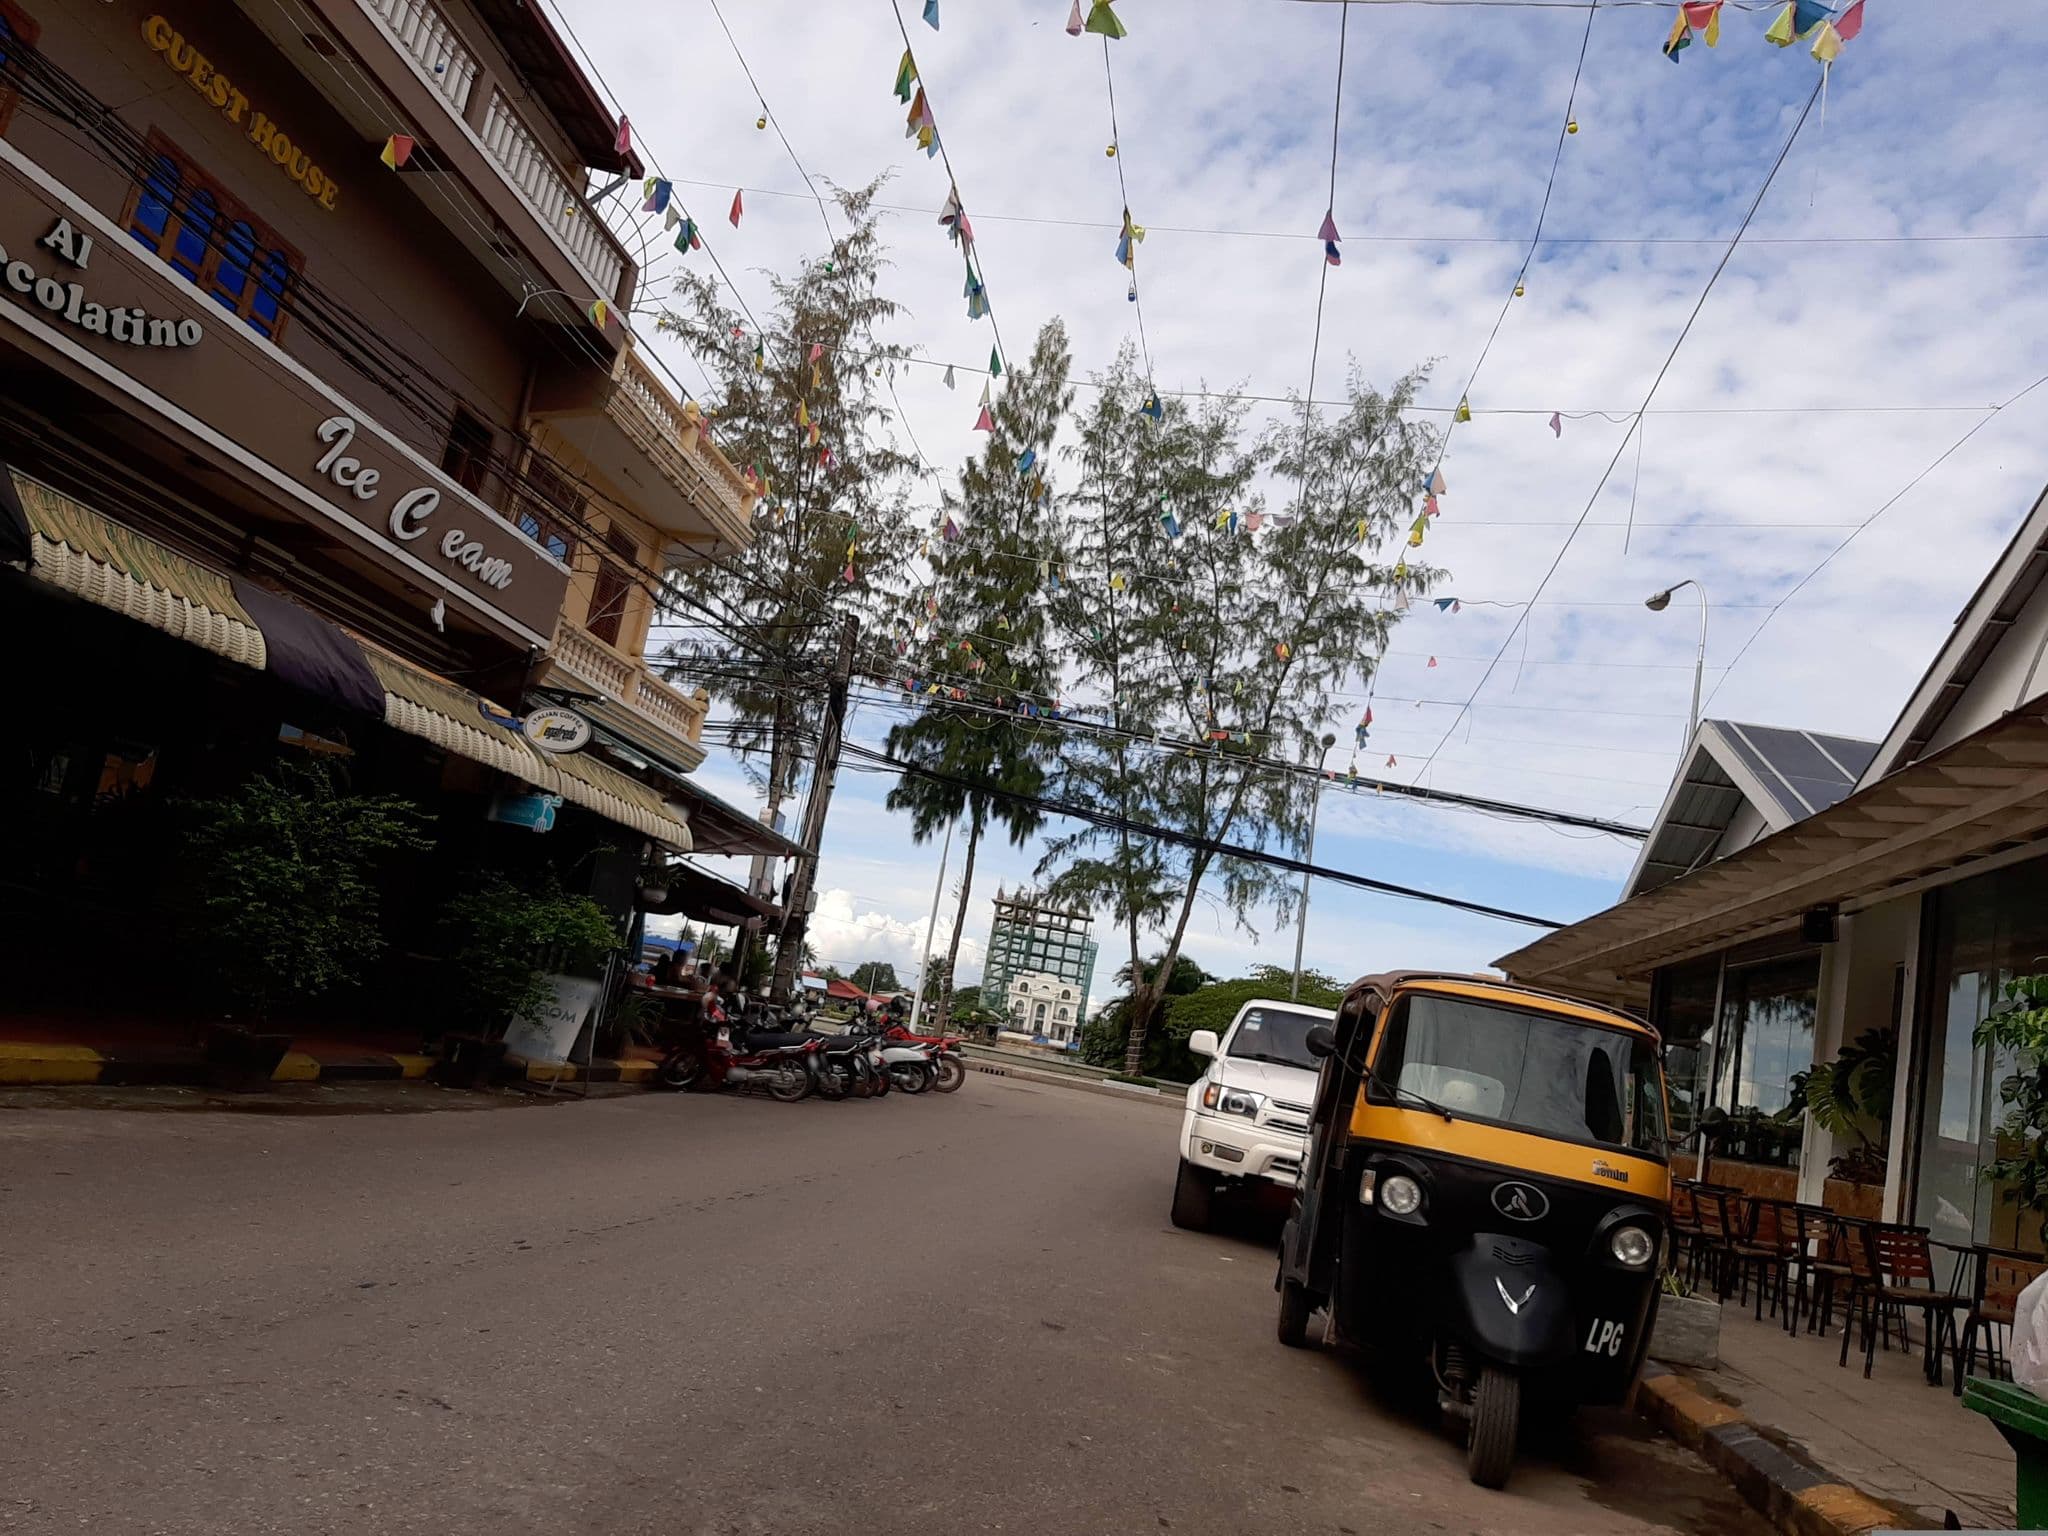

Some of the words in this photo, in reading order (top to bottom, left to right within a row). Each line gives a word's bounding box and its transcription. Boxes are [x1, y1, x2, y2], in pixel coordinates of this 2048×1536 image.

[140, 15, 249, 123] GUEST
[246, 111, 338, 211] HOUSE
[44, 217, 94, 269] Al
[0, 243, 203, 347] colatino
[315, 416, 380, 499] Ice
[531, 711, 559, 725] ITALIAN
[559, 711, 584, 730] COFFEE
[1585, 1317, 1625, 1357] LPG
